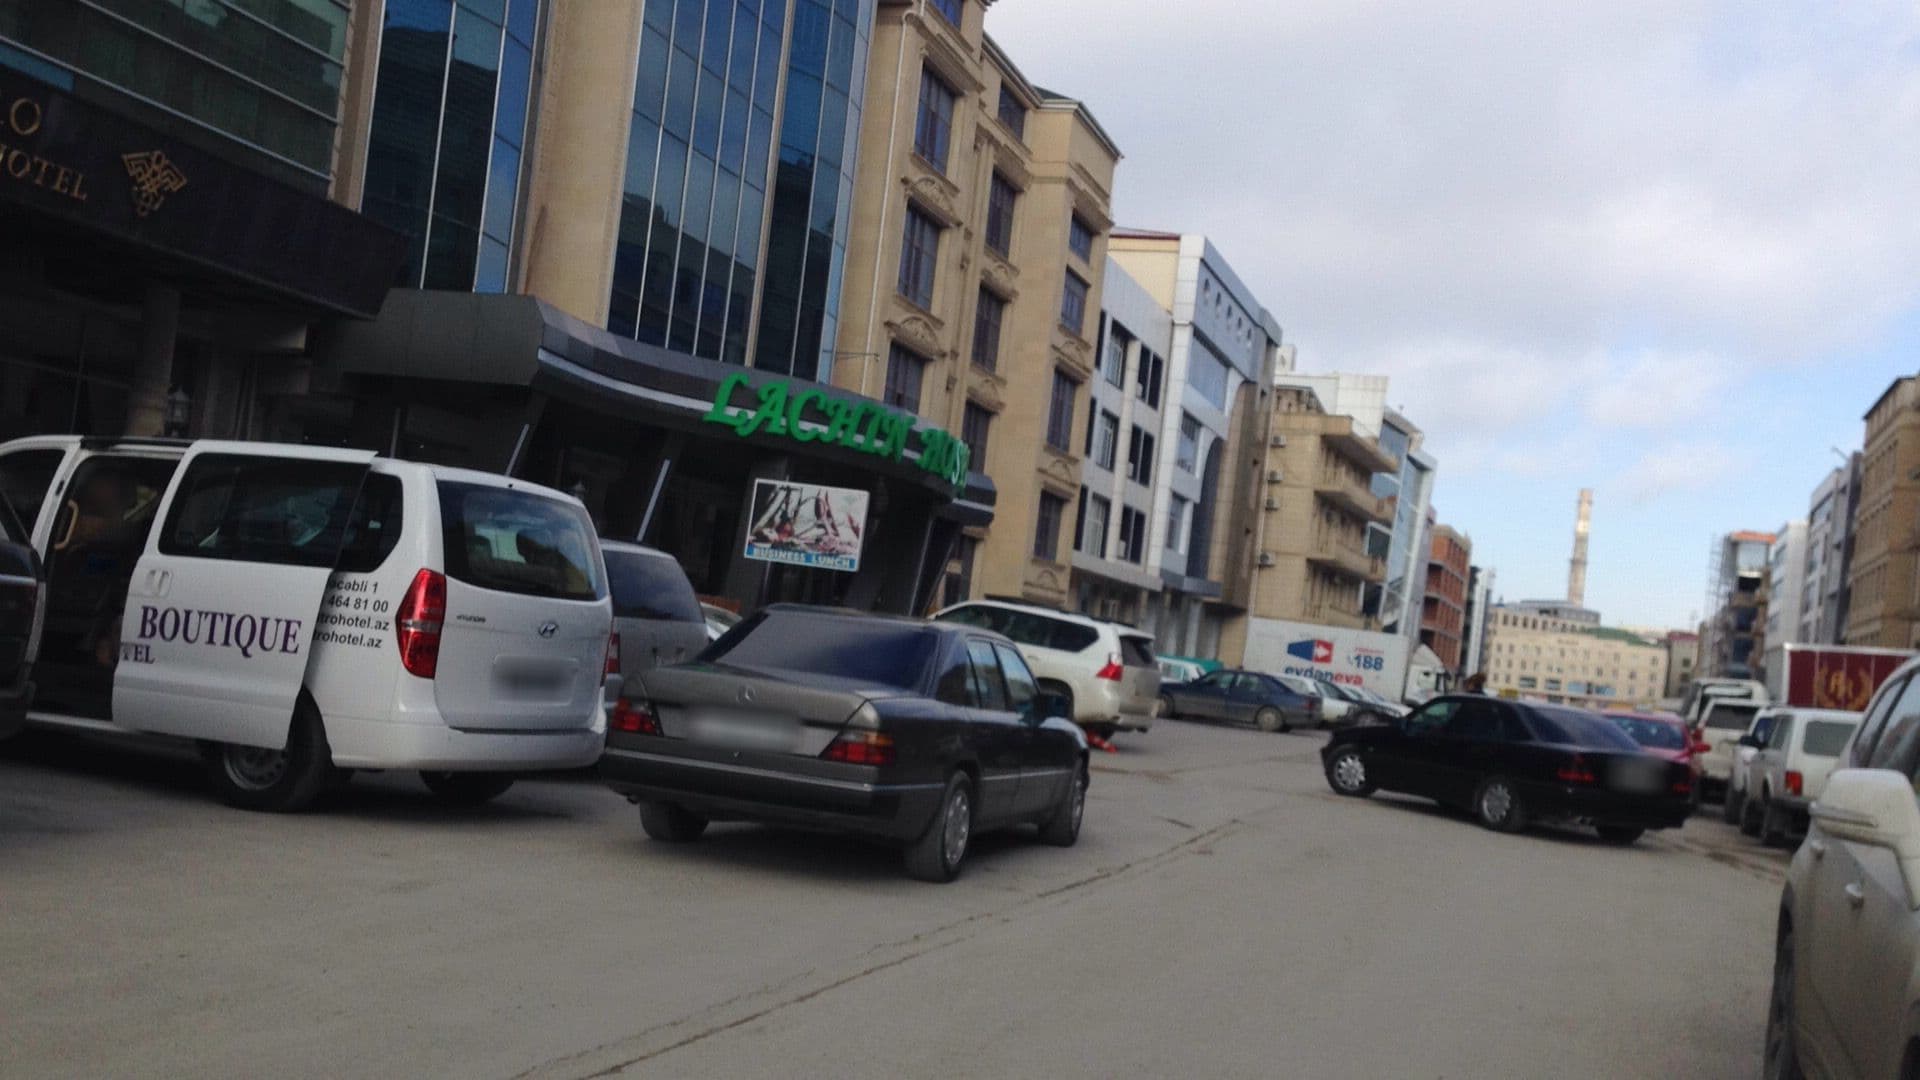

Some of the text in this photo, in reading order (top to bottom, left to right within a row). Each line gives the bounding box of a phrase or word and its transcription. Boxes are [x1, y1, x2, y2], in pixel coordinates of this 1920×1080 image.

[703, 371, 916, 463] LACHIN
[752, 546, 851, 569] BUSINESS LUNCH
[328, 594, 389, 613] 464 81 00
[138, 605, 302, 658] BOUTIQUE
[1354, 655, 1384, 671] 188
